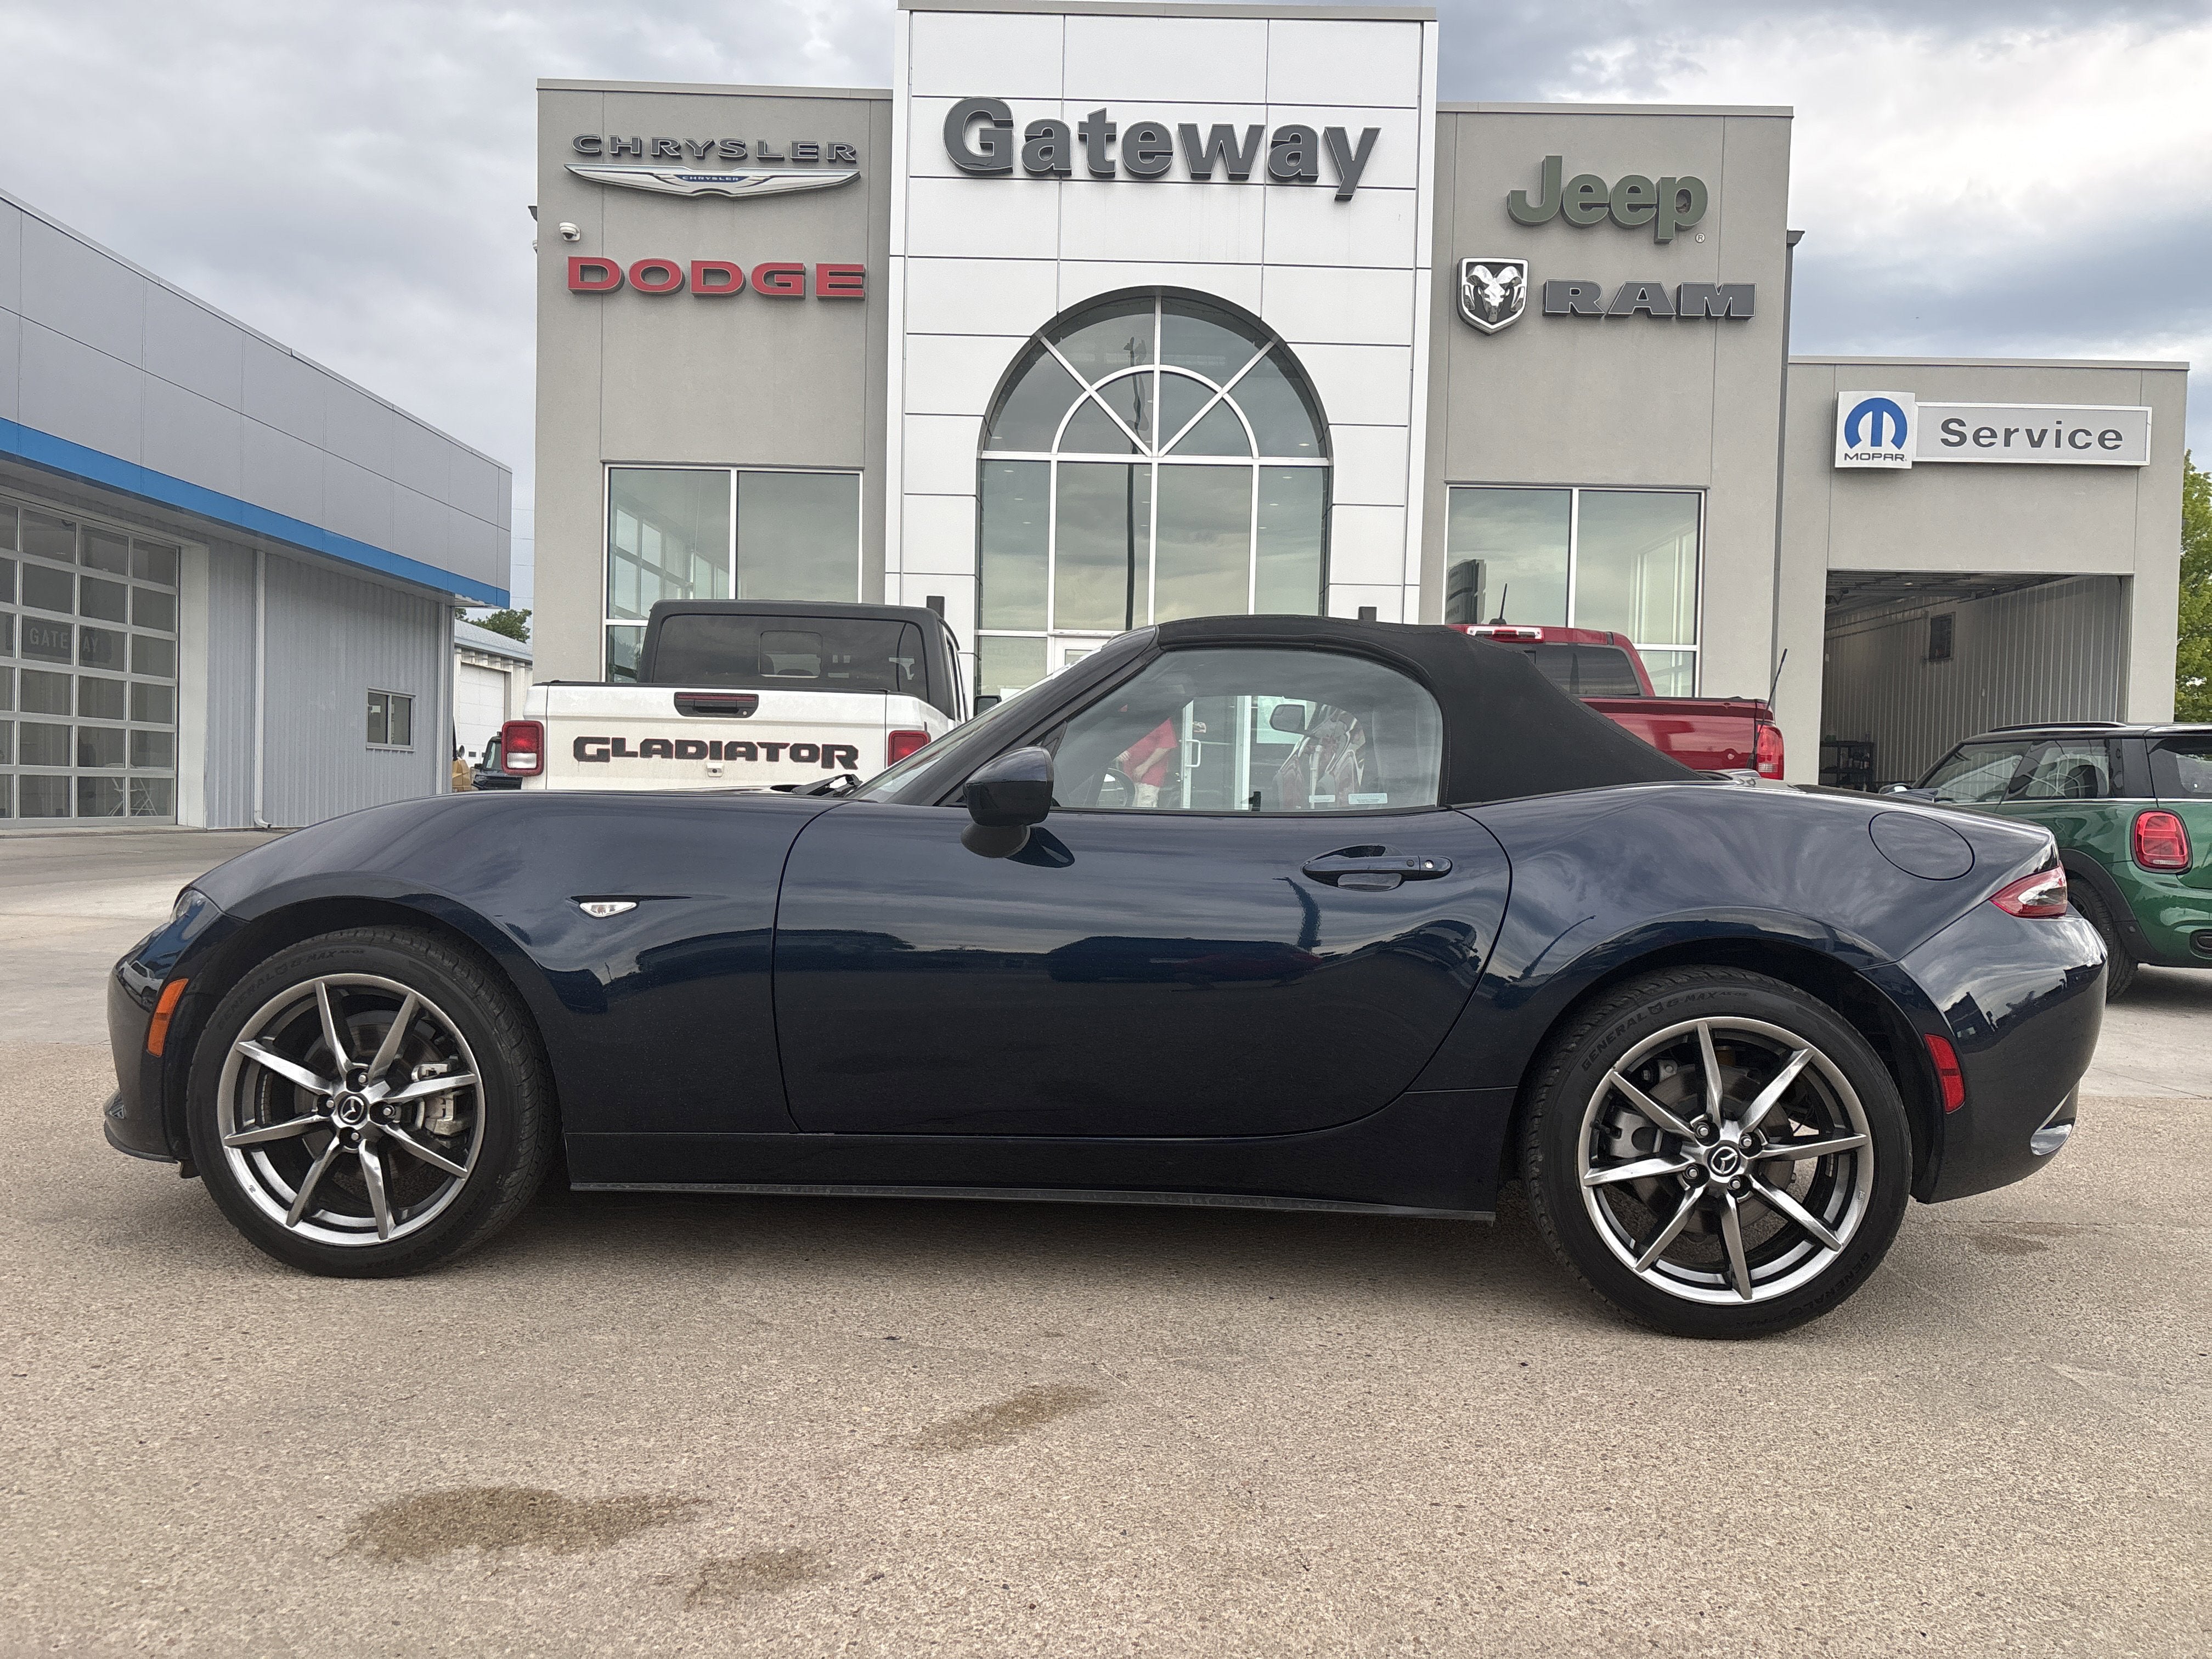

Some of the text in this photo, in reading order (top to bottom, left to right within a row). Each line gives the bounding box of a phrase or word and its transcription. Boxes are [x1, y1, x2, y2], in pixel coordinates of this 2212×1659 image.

[571, 133, 856, 163] CHRYSLER
[943, 96, 1381, 201] Gateway
[1507, 155, 1708, 244] Jeep
[567, 256, 866, 299] DODGE
[1542, 279, 1757, 320] RAM
[1940, 417, 2123, 450] Service
[1844, 453, 1905, 461] MOPAR
[30, 627, 99, 653] GATEAY
[573, 736, 859, 770] GLADIATOR
[1581, 1013, 1648, 1072] GENERAL
